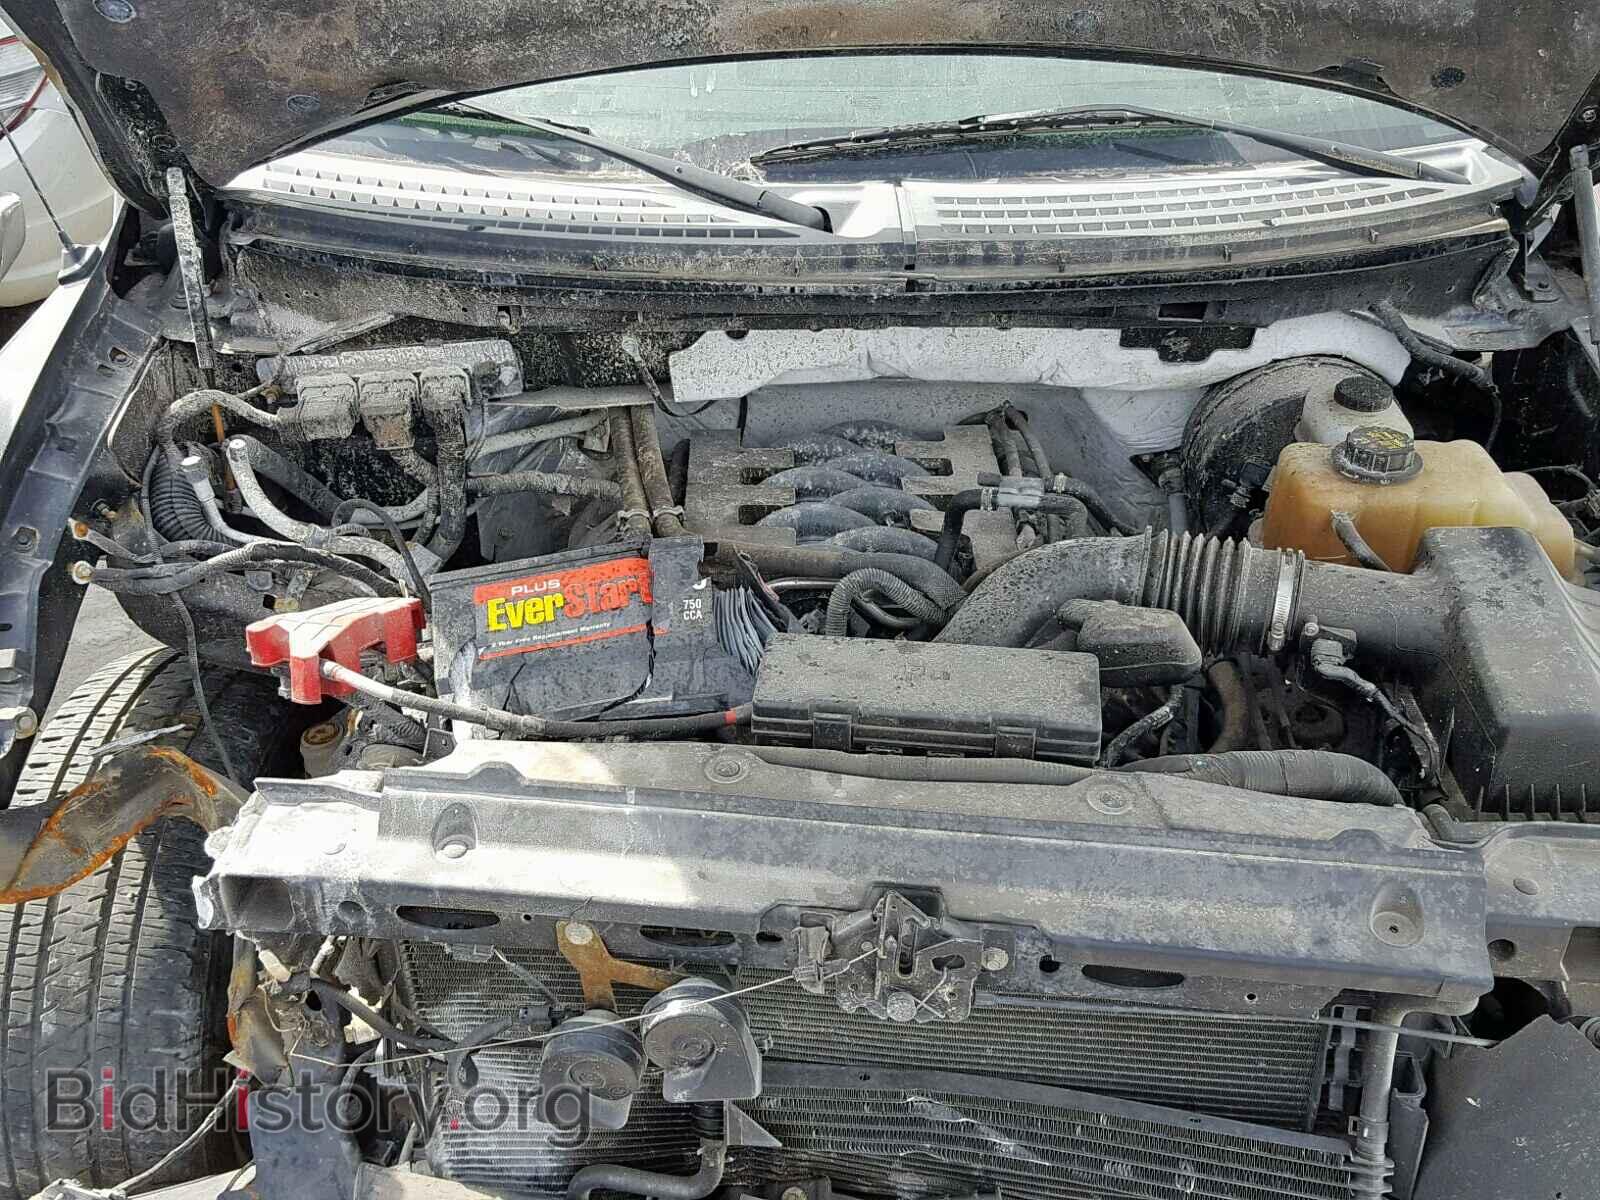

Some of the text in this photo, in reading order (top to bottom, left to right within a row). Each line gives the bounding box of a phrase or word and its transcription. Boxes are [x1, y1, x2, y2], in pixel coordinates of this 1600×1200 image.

[511, 578, 561, 596] PLUS
[682, 598, 702, 610] 750
[683, 609, 703, 621] CCA
